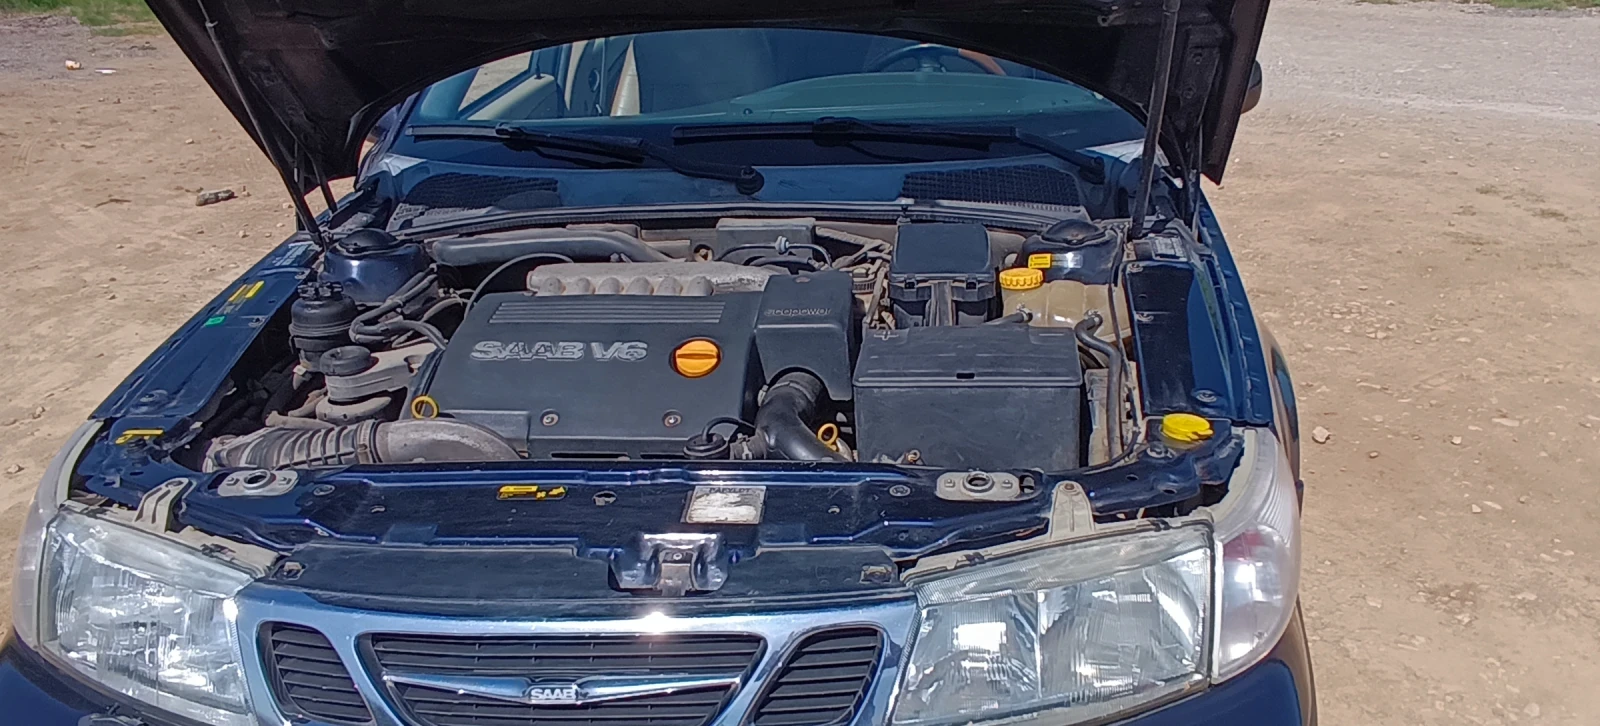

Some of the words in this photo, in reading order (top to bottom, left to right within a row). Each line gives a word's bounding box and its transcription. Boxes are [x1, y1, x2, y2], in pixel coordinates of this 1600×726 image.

[470, 341, 585, 361] SAAB
[590, 341, 648, 361] V6
[530, 688, 577, 700] SAAB
